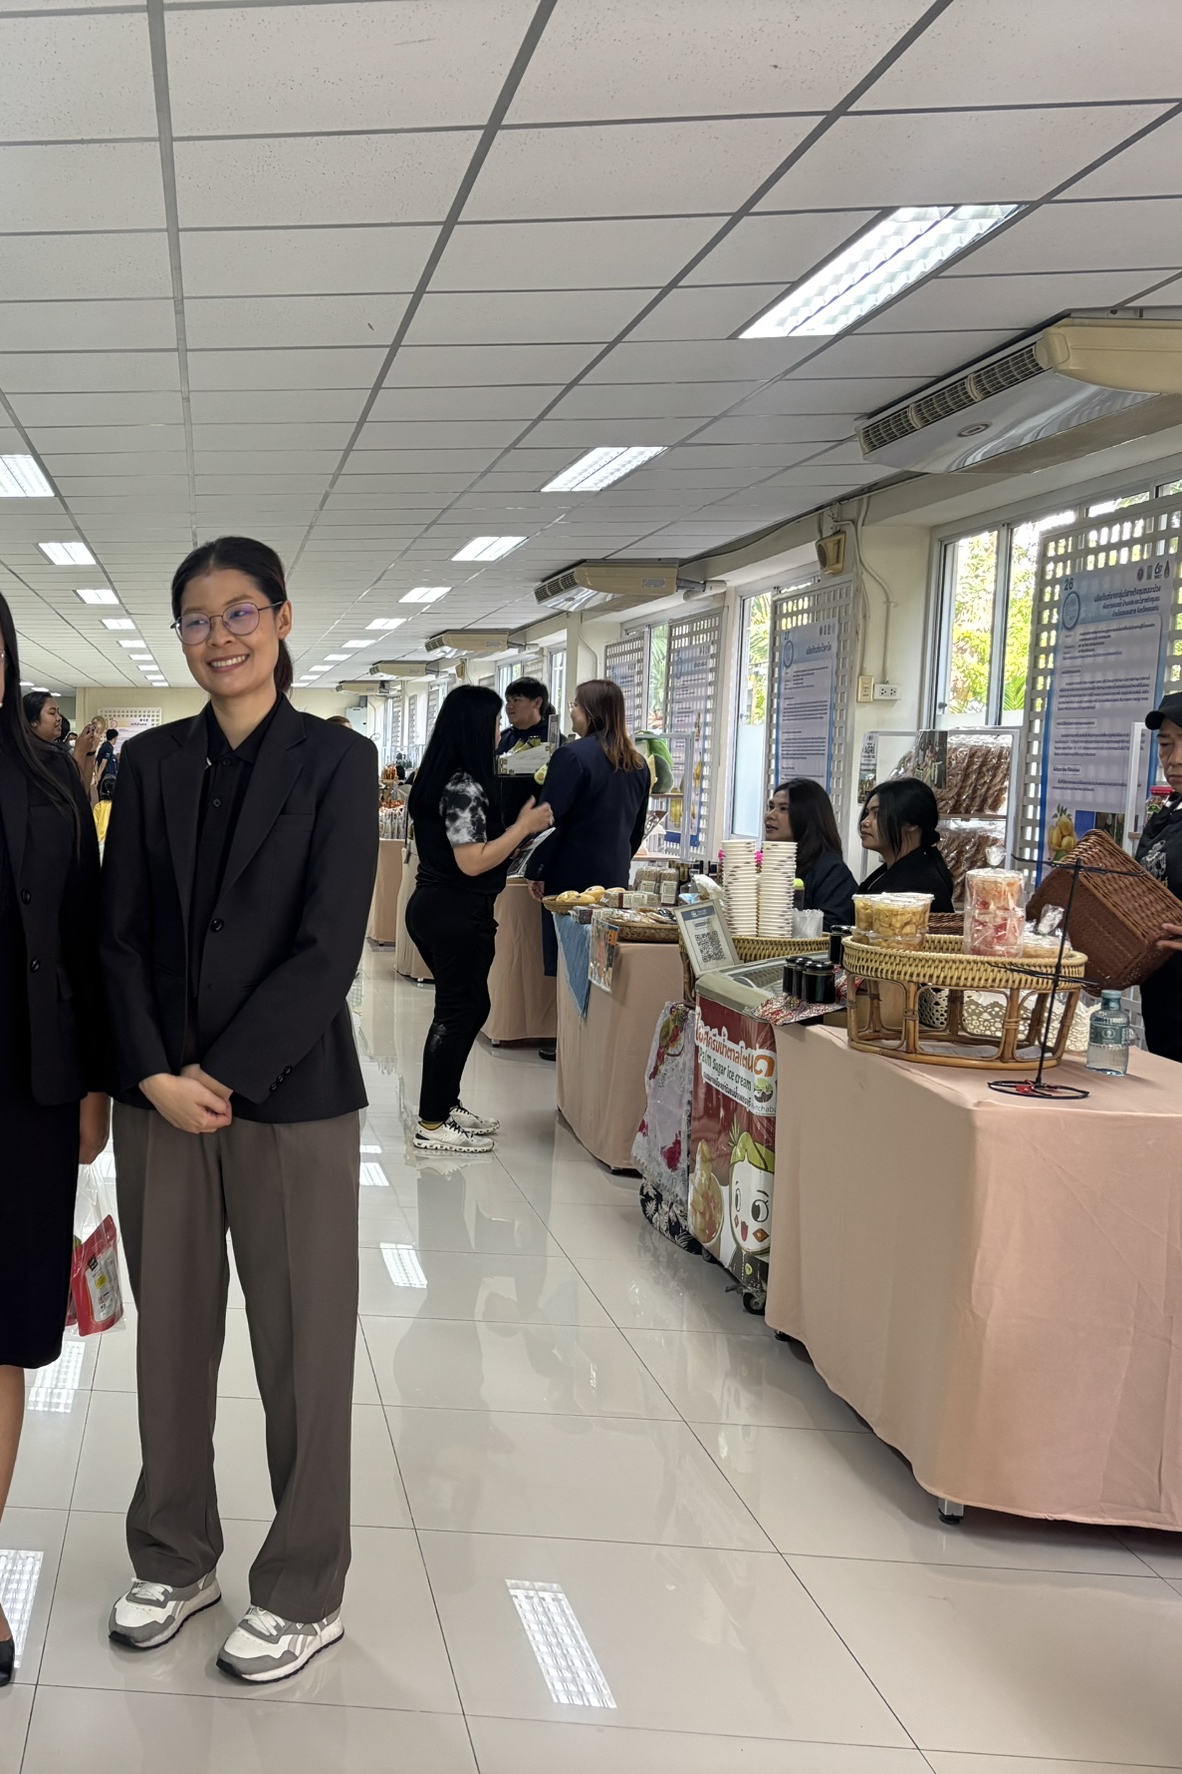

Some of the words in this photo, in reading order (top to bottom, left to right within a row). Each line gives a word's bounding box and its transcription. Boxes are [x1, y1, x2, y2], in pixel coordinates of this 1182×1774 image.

[1064, 578, 1073, 590] 26
[727, 1065, 735, 1081] ice
[735, 1074, 752, 1091] cream
